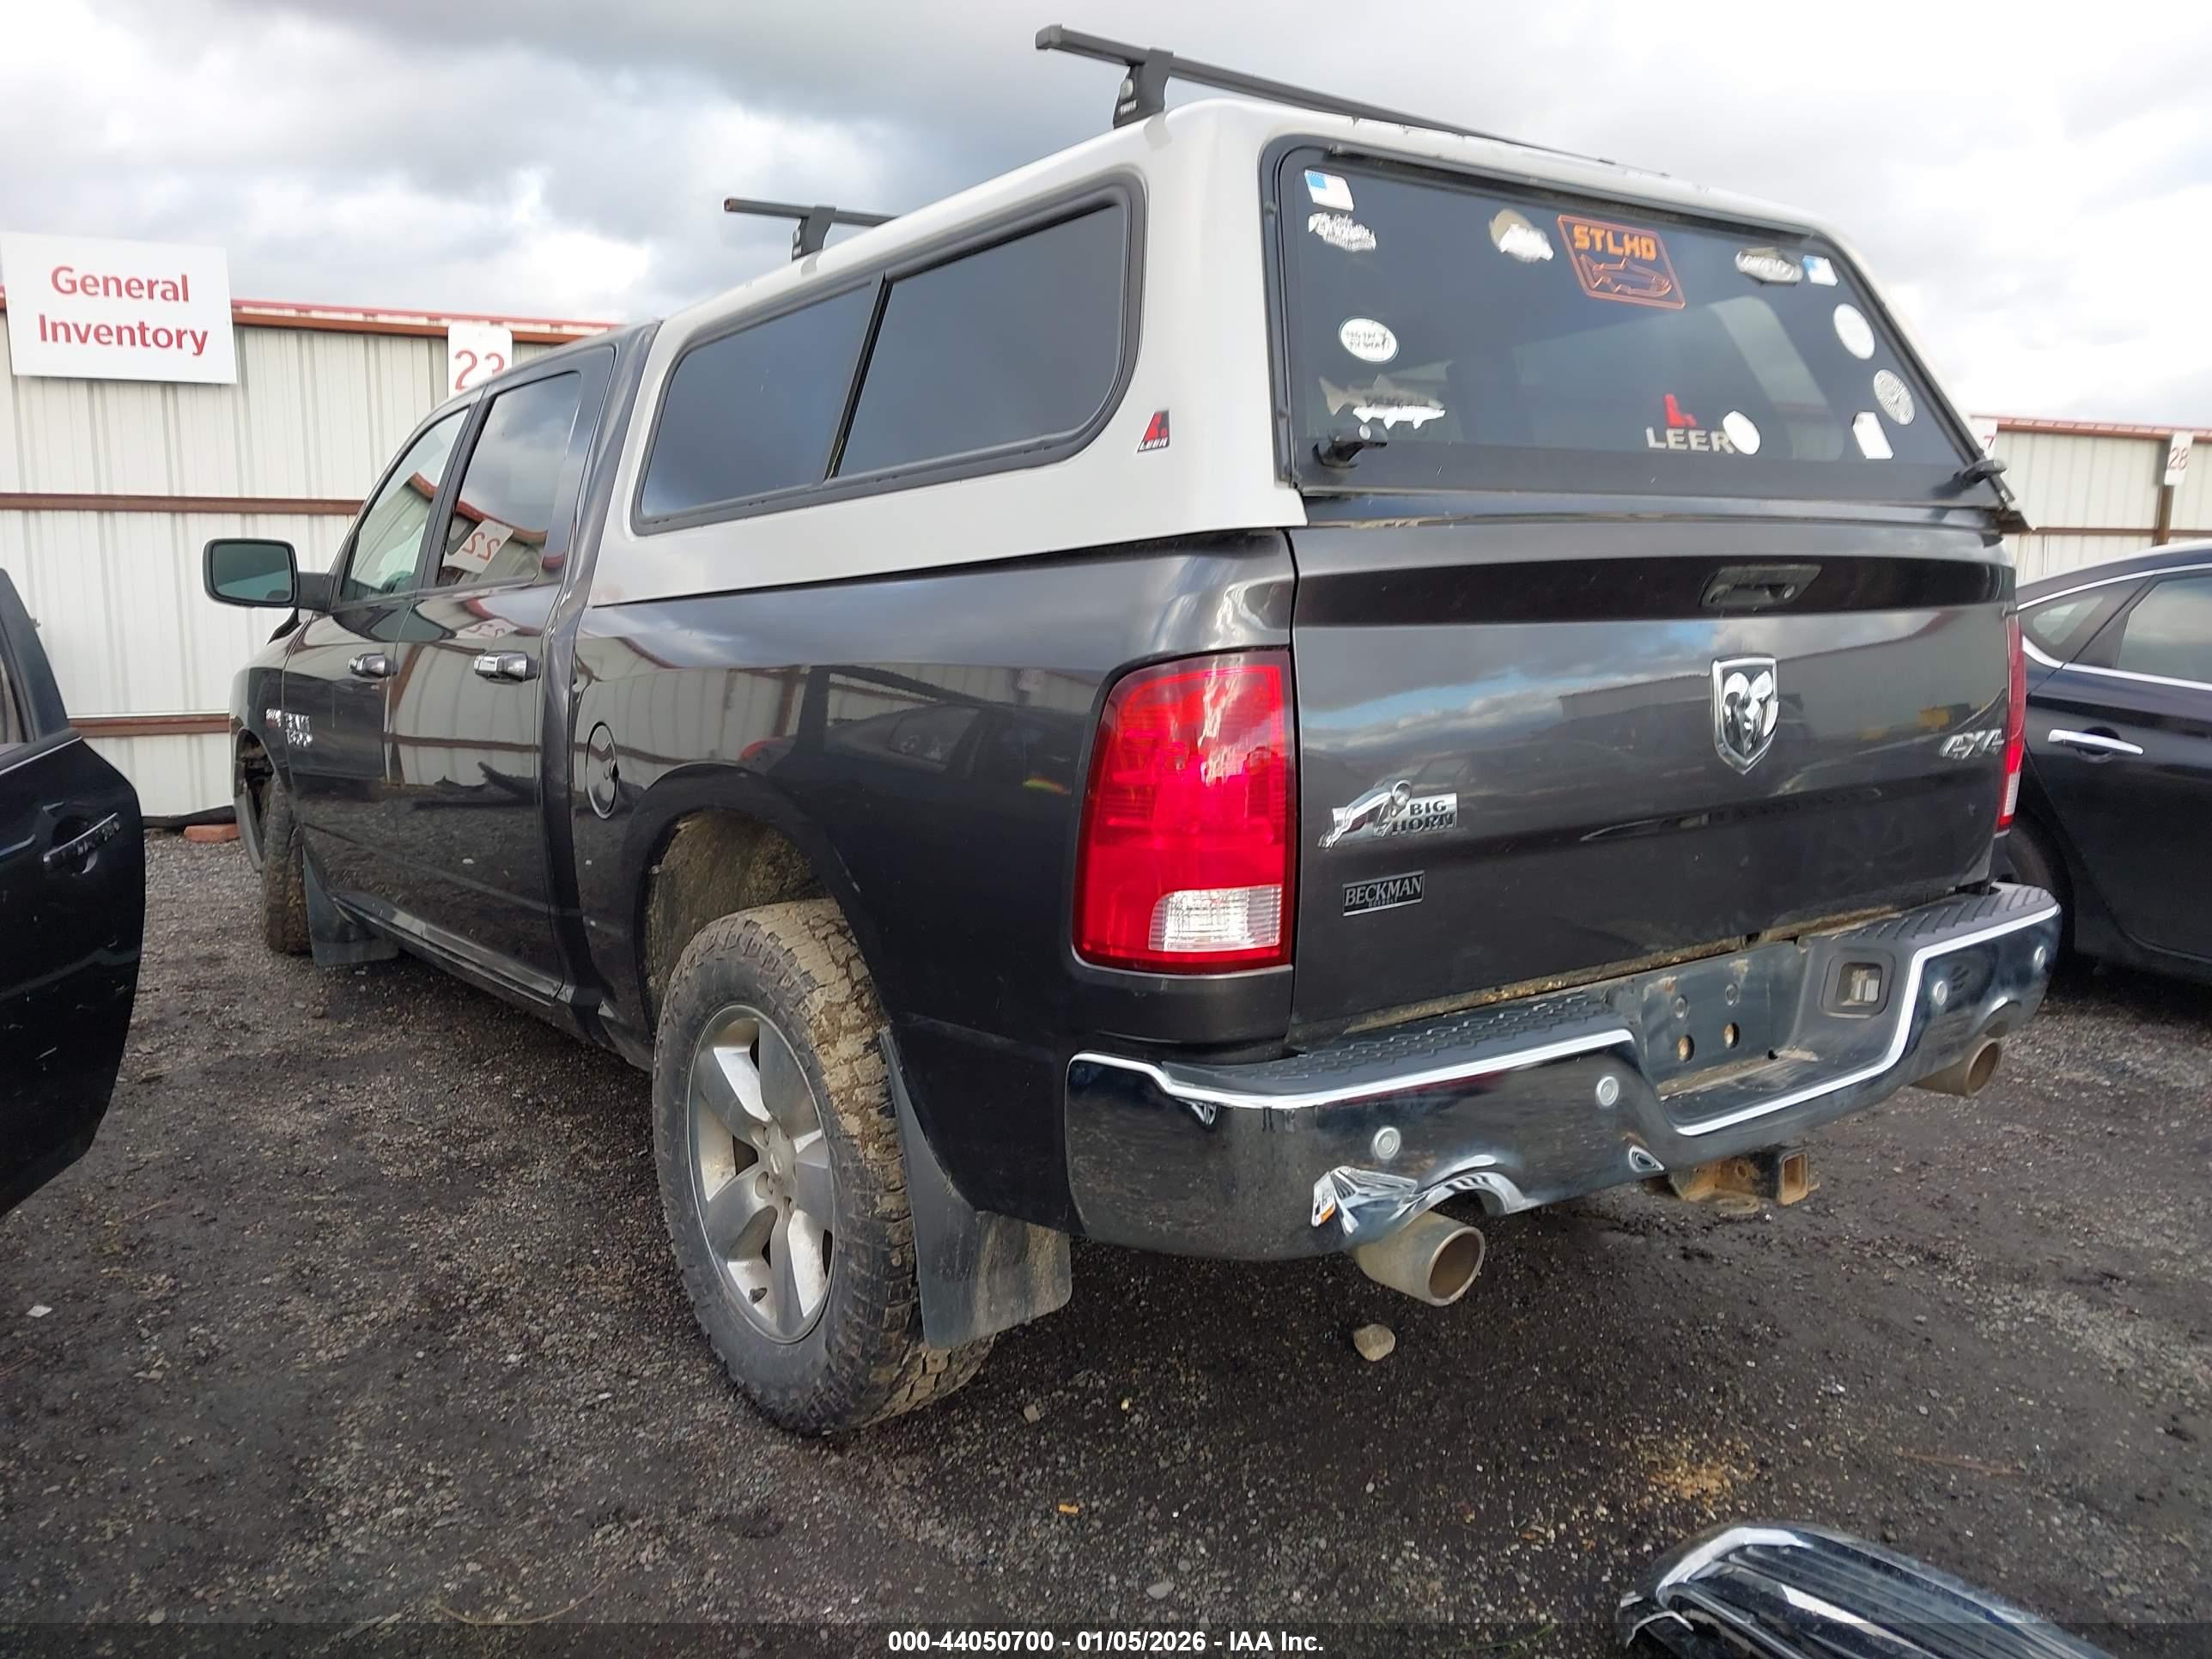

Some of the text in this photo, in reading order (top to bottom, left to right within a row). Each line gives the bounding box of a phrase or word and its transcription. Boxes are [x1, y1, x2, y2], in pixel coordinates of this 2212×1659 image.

[1573, 224, 1657, 261] STLHD
[51, 265, 190, 303] General
[39, 313, 209, 356] Inventory
[1646, 426, 1735, 453] LEER
[2167, 447, 2189, 470] 28
[1410, 799, 1447, 815] BIG
[1392, 812, 1455, 833] HORN
[1345, 877, 1423, 907] BECKMAN
